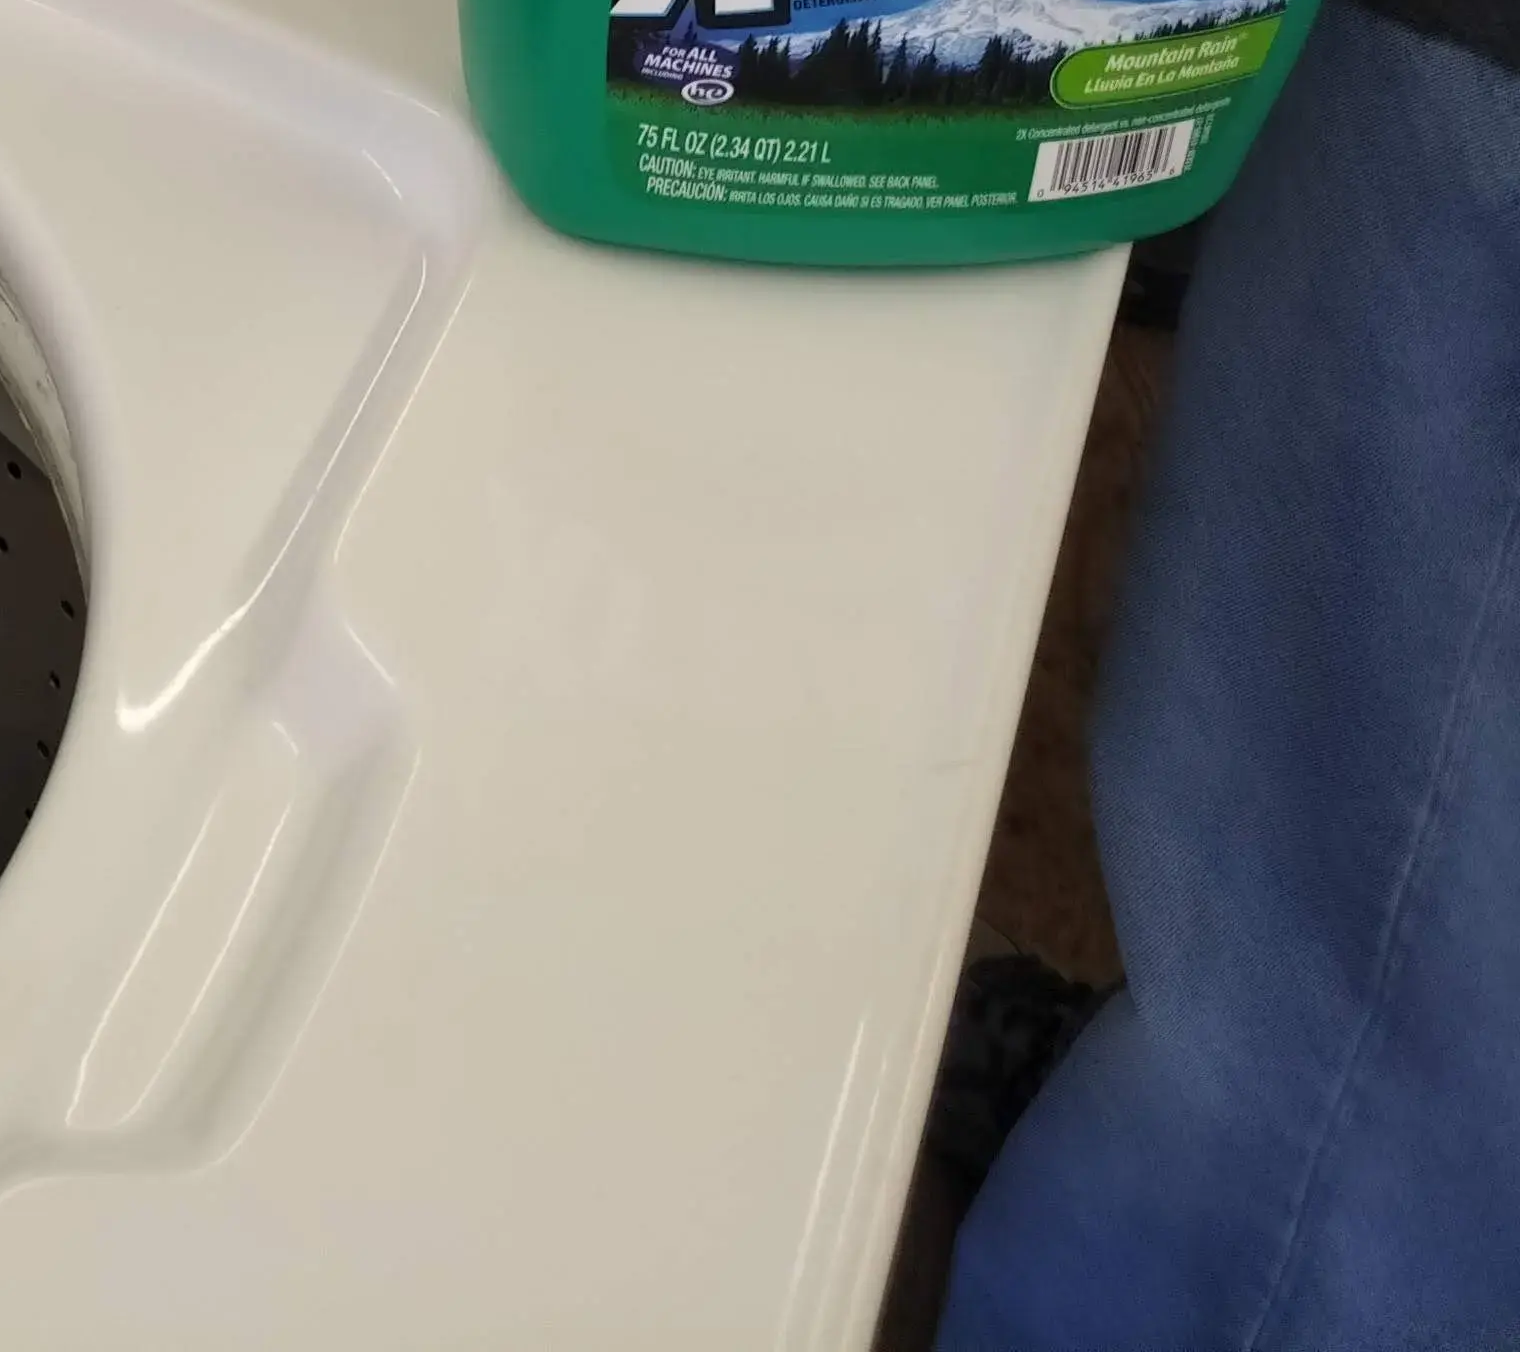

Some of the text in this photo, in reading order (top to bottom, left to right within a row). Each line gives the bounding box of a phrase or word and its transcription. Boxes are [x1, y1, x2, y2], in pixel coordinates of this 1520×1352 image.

[644, 53, 734, 79] MACHINES
[662, 46, 718, 63] FOR ALL
[1104, 34, 1238, 73] Mountain Rain
[641, 67, 684, 80] INCLUDING
[1084, 55, 1240, 94] Lluvia En La Montaña
[637, 123, 831, 165] 75 FL OZ (2.34 QT) 2.21 L
[1028, 123, 1081, 139] Concentrated
[639, 152, 940, 189] CAUTION: EYE IRRITANT. HARMFUL IF SWALLOWED. SEE BACK PANEL.
[1063, 179, 1105, 195] 94514
[1112, 172, 1153, 188] 41965
[646, 175, 728, 201] PRECAUCIÓN:
[729, 190, 757, 204] IRRITA
[758, 191, 775, 205] LOS
[804, 194, 833, 208] CAUSA
[860, 195, 870, 208] SI
[870, 195, 883, 208] ES
[925, 195, 943, 209] VER
[943, 195, 969, 209] PANEL
